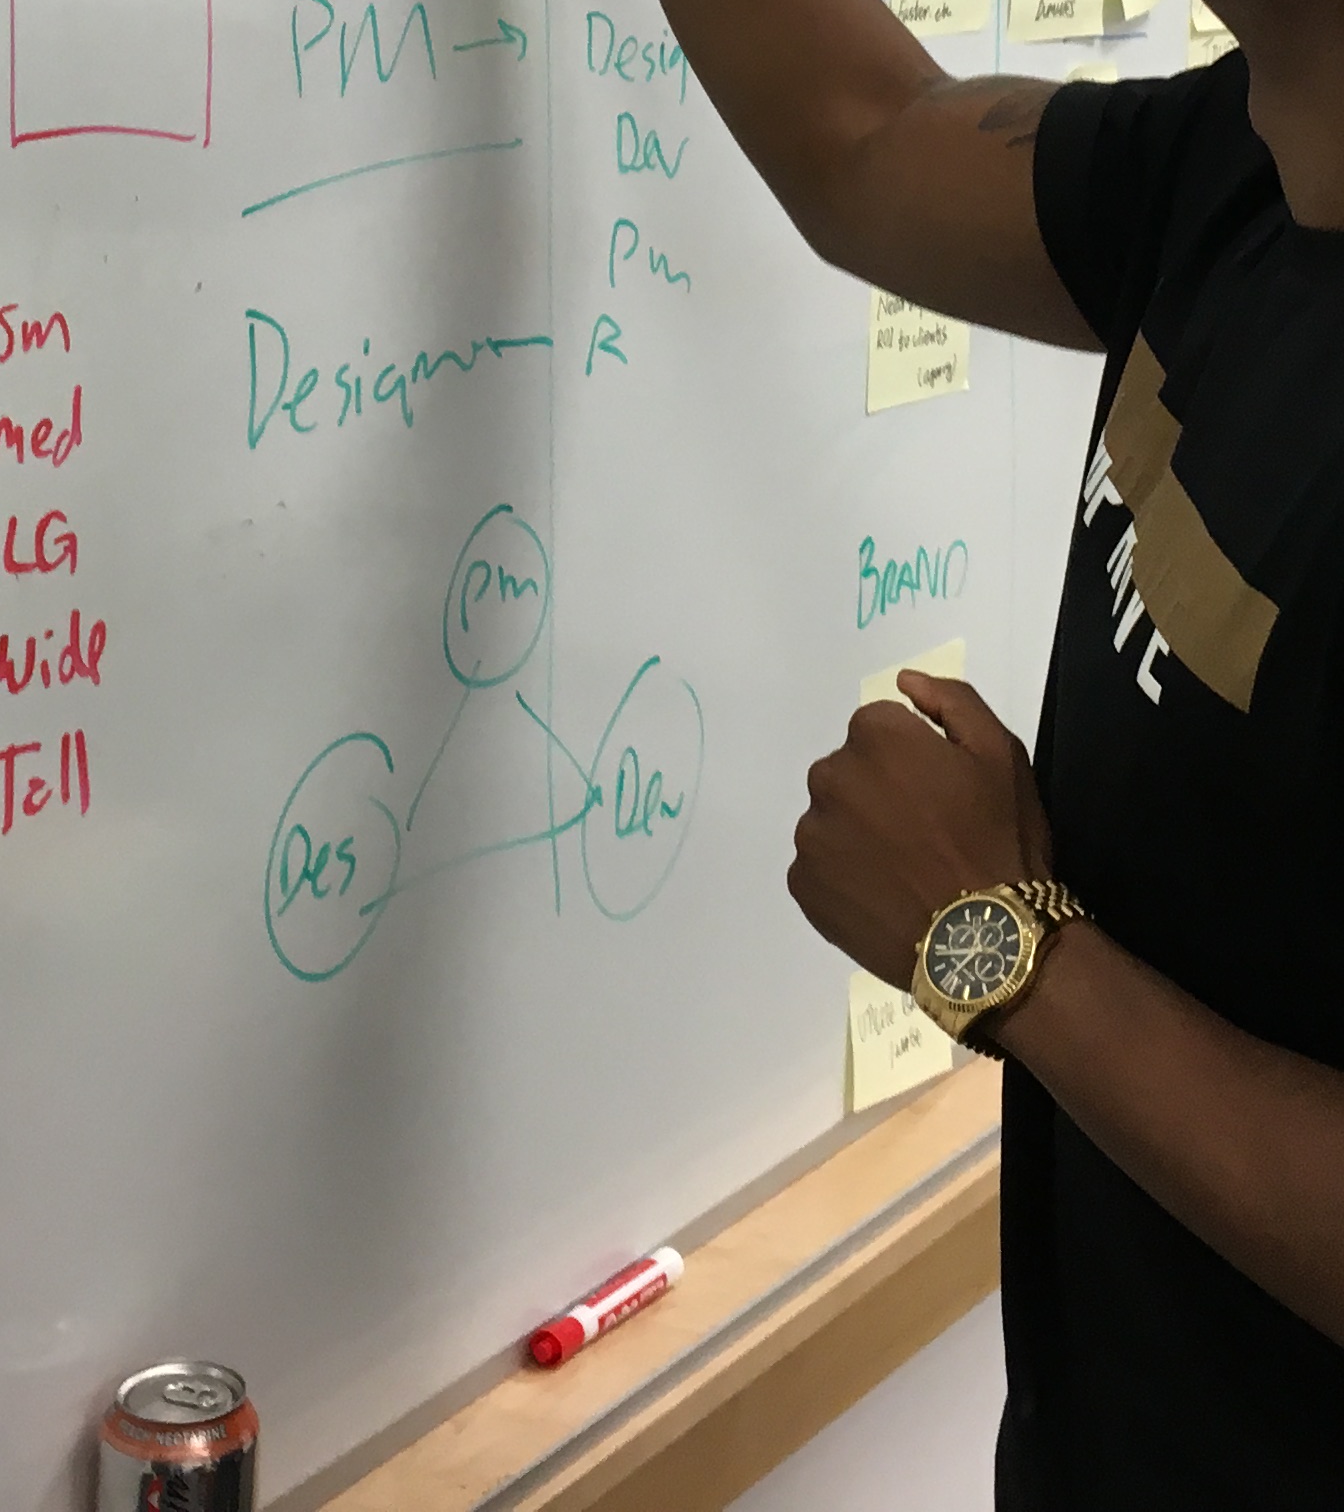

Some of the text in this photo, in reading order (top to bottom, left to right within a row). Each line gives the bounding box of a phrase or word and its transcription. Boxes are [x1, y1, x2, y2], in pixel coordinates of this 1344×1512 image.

[585, 11, 690, 103] Desig
[617, 111, 690, 179] Dev
[585, 313, 629, 376] R
[3, 510, 78, 575] LG
[857, 534, 970, 631] BRAND
[615, 746, 685, 837] Dev
[277, 824, 357, 917] Des
